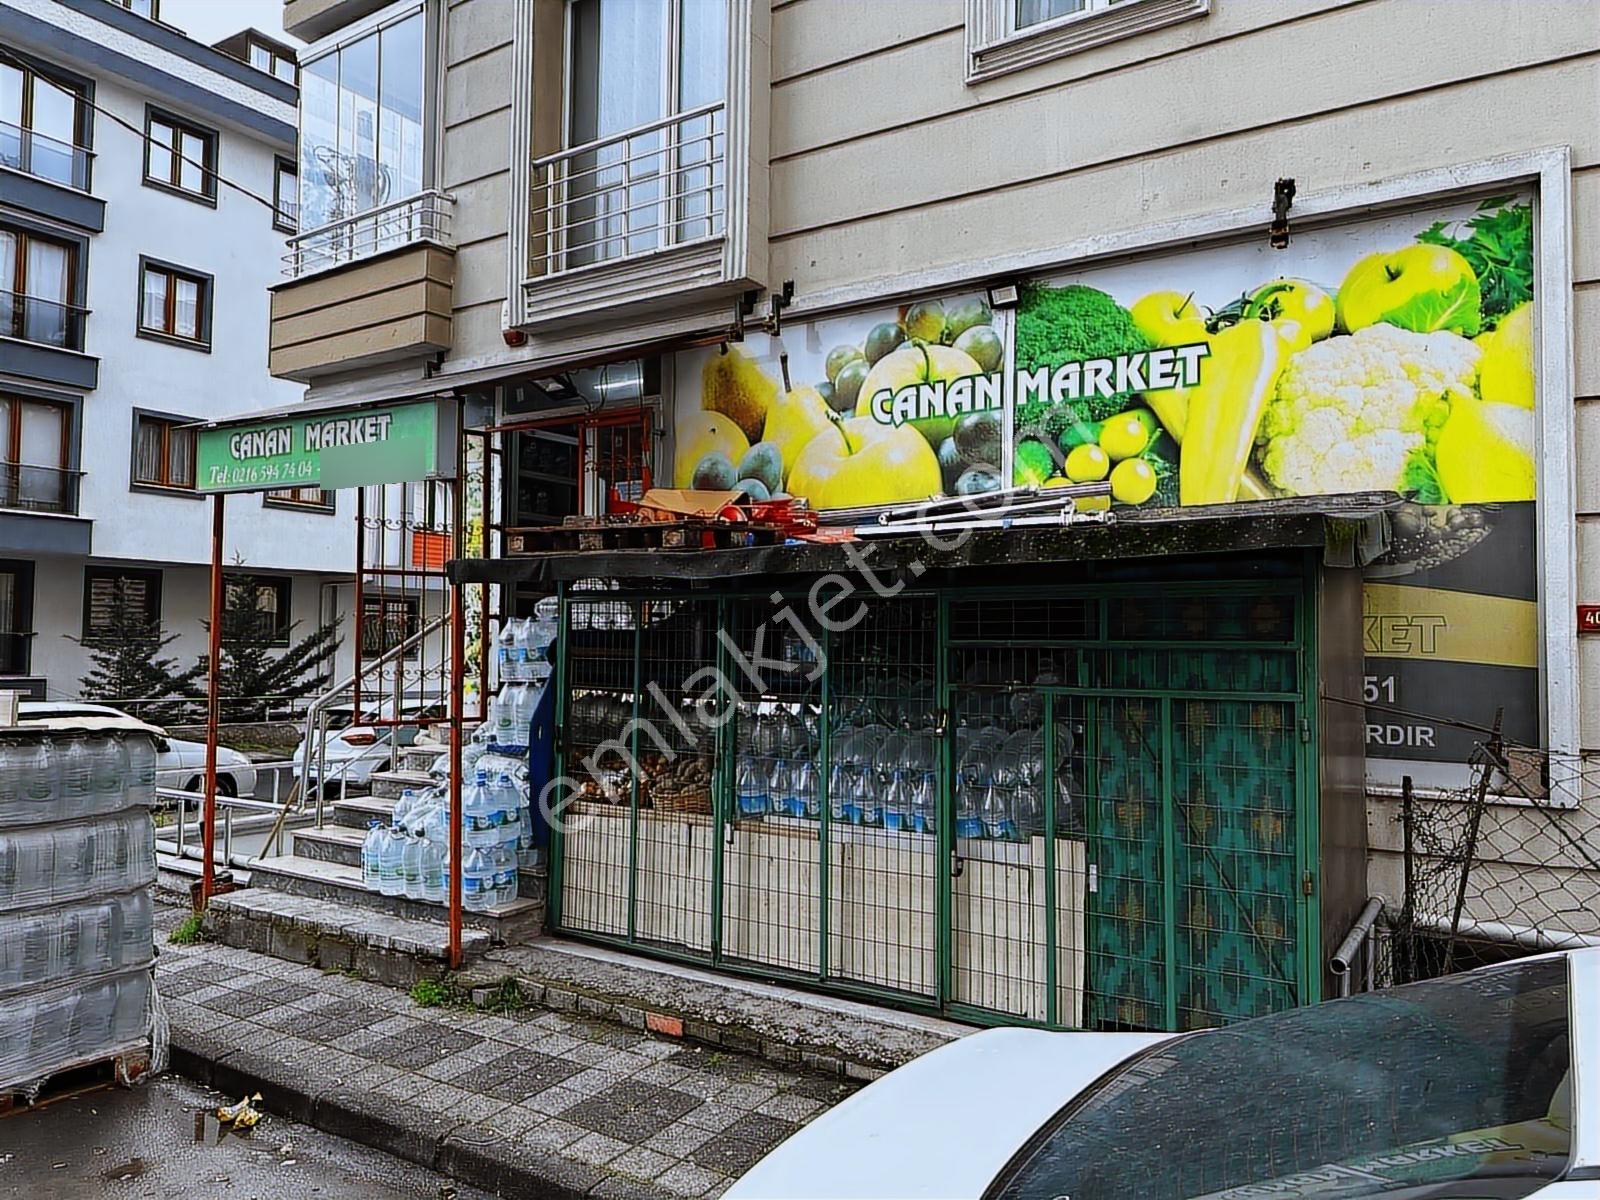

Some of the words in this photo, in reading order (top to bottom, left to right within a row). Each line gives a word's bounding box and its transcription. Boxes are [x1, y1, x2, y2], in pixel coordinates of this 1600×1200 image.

[872, 372, 1003, 427] CANAN
[1016, 342, 1211, 406] MARKET
[230, 427, 292, 461] CANAN
[304, 413, 392, 451] MARKET
[232, 466, 258, 483] 0216
[298, 460, 312, 477] 04
